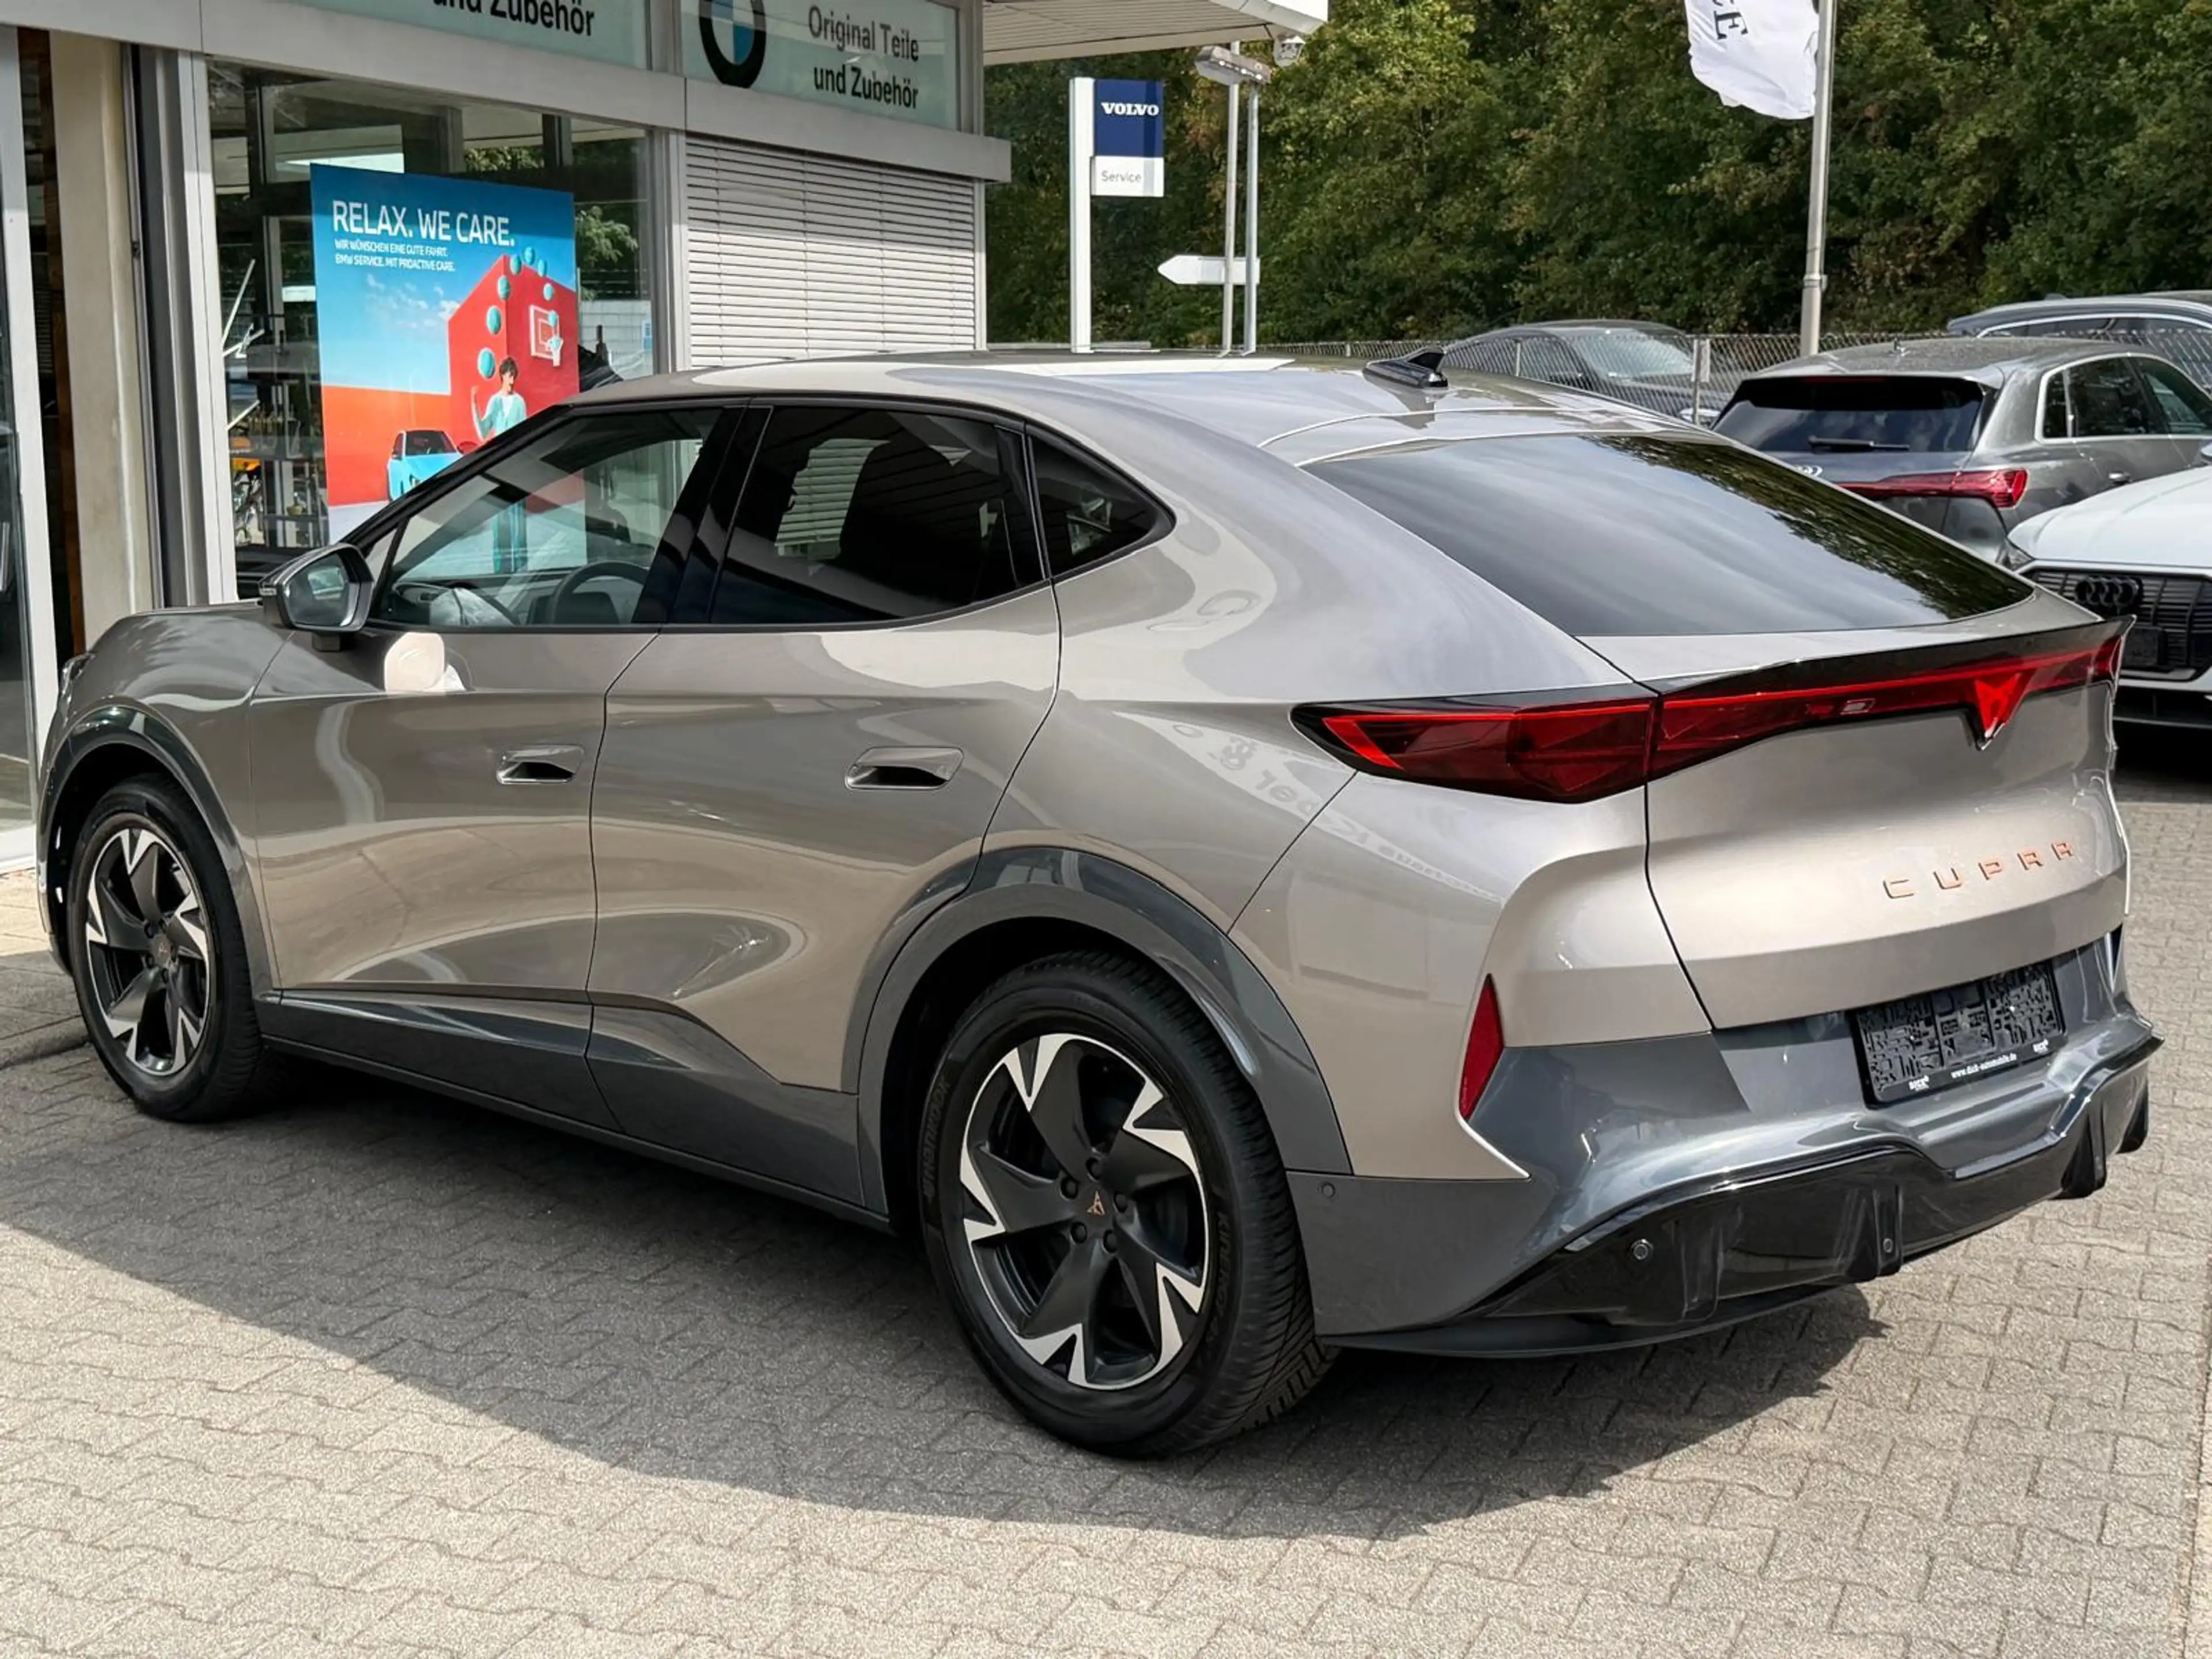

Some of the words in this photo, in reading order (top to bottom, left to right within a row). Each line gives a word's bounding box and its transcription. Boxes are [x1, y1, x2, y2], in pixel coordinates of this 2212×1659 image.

[809, 5, 875, 52] Original
[880, 22, 919, 62] Teile
[814, 64, 846, 96] und
[851, 65, 919, 109] Zubehör
[1101, 102, 1160, 116] VOLVO
[1101, 170, 1142, 183] Service
[332, 200, 413, 238] RELAX.
[418, 208, 452, 241] WE
[456, 212, 515, 247] CARE.
[334, 237, 349, 250] WIR
[1883, 840, 2074, 899] CUPRA
